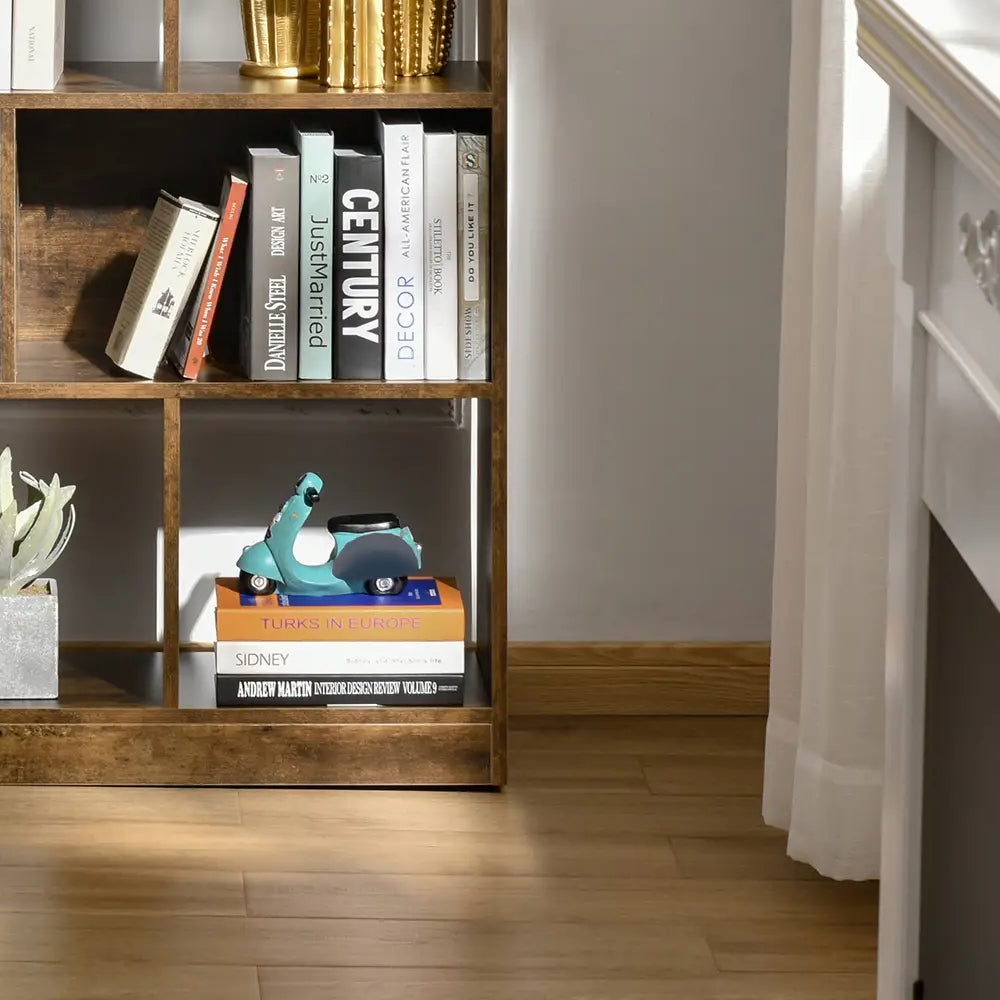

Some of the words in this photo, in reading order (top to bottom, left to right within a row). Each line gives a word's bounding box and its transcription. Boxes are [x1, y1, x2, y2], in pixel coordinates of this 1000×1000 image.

[400, 134, 410, 167] FLAIR
[272, 206, 286, 223] ART
[401, 168, 410, 258] ALL-AMERICAN
[468, 202, 475, 212] IT
[270, 231, 285, 256] DESIGN
[433, 218, 443, 263] STILETTO
[212, 260, 223, 278] Wish
[341, 188, 380, 343] CENTURY
[468, 266, 475, 283] DO
[207, 283, 218, 300] Knew
[433, 268, 443, 295] BOOK
[265, 274, 286, 314] STEEL
[202, 301, 213, 319] When
[397, 276, 415, 360] DECOR
[198, 324, 208, 337] Was
[464, 307, 472, 360] SIDESHOW
[264, 313, 287, 371] DANIELLE
[260, 618, 320, 630] TURKS
[326, 618, 343, 630] IN
[348, 617, 422, 630] EUROPE
[236, 652, 290, 666] SIDNEY
[238, 681, 276, 698] ANDREW
[278, 680, 312, 697] MARTIN
[314, 682, 346, 695] INTERIOR
[346, 682, 374, 694] DESIGN
[374, 682, 400, 694] REVIEW
[402, 681, 432, 694] VOLUME
[432, 682, 437, 694] 9
